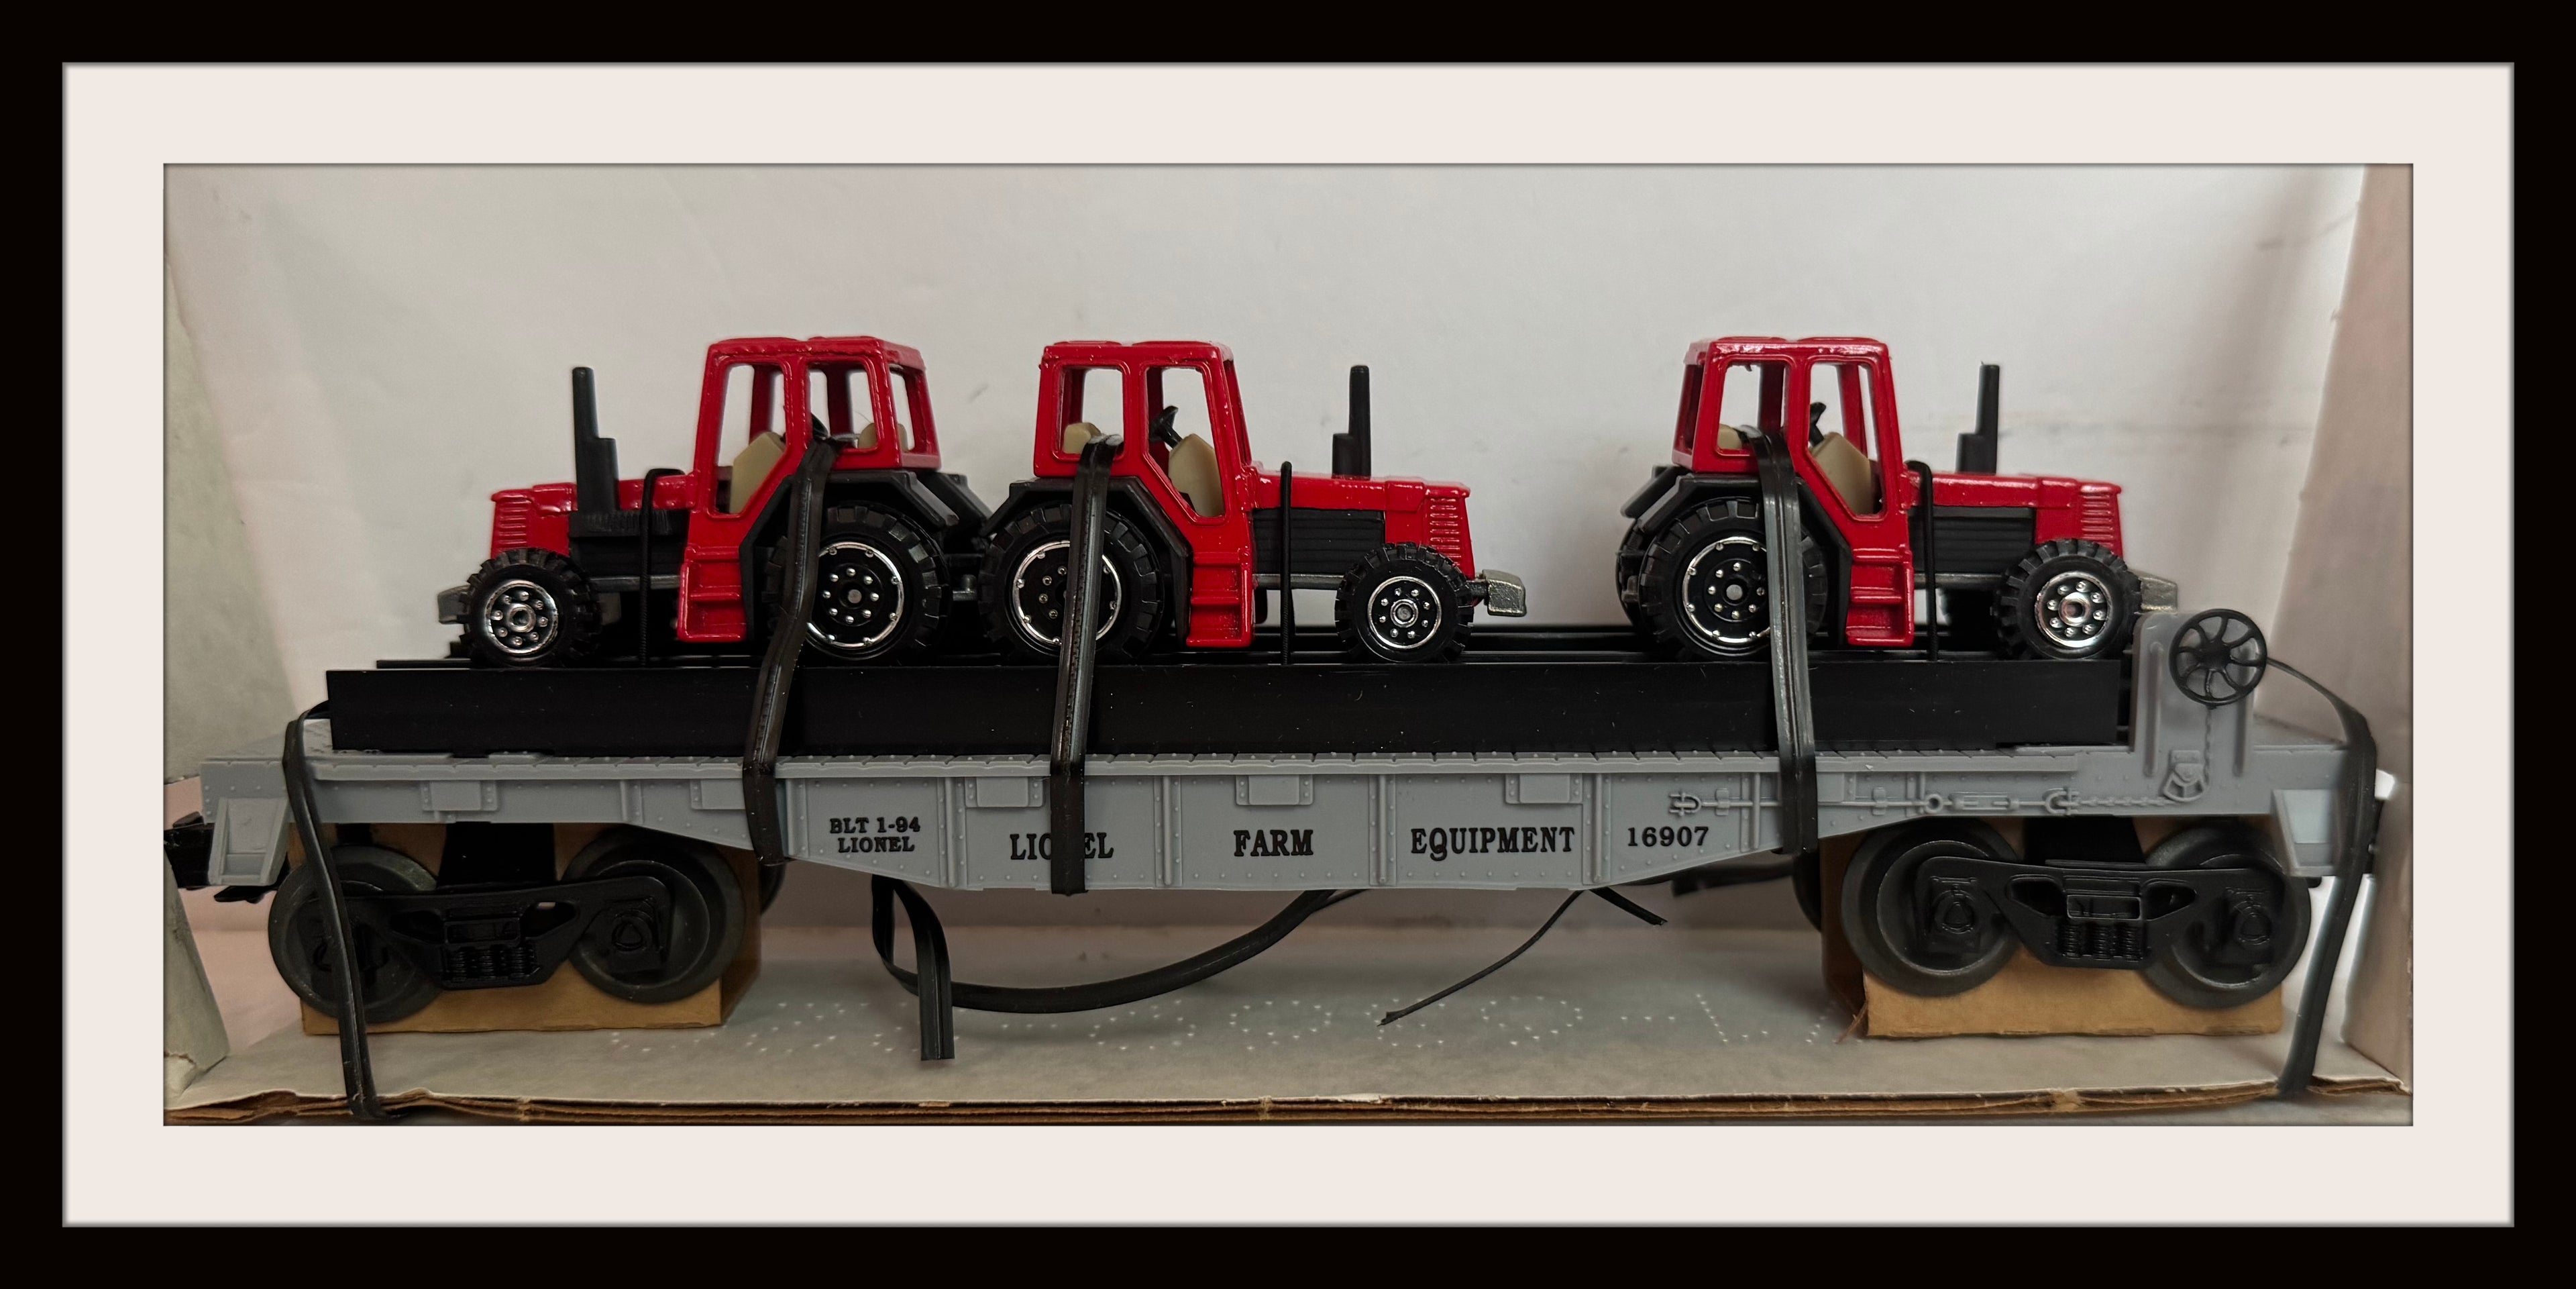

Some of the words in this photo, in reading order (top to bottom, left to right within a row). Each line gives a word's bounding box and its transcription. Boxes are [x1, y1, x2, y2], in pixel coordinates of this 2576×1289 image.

[829, 817, 869, 834] BLT
[876, 816, 921, 833] 1-94
[837, 835, 915, 854] LIONEL
[1009, 831, 1114, 860] LIOEL
[1233, 829, 1314, 858] FARM
[1410, 826, 1575, 862] EQUIPMENT
[1627, 826, 1709, 847] 16907
